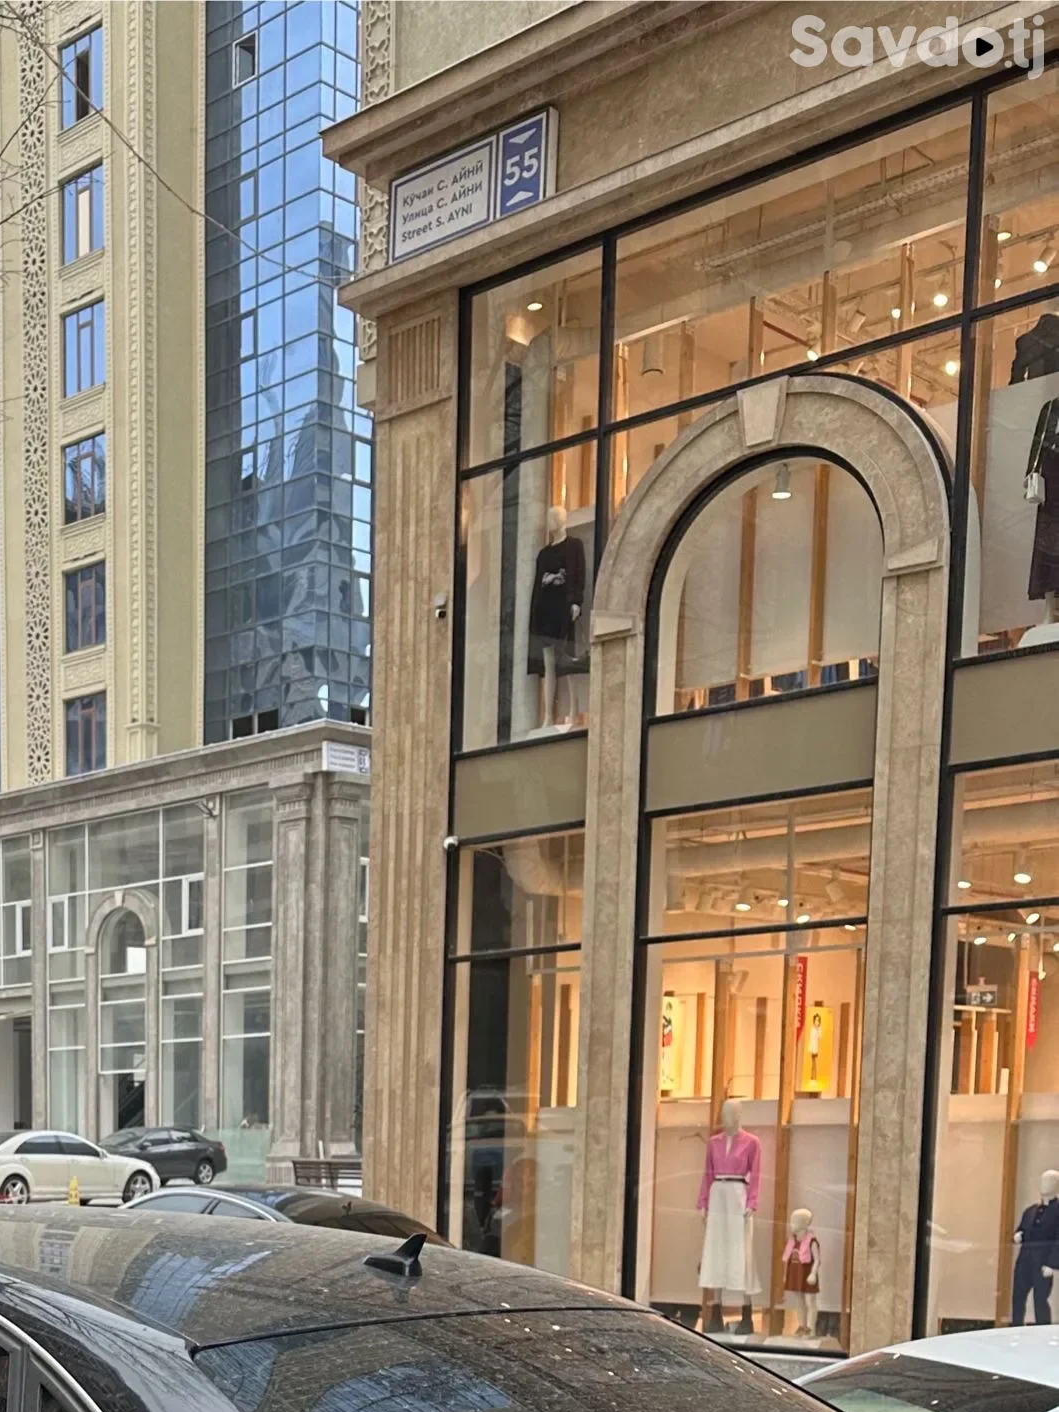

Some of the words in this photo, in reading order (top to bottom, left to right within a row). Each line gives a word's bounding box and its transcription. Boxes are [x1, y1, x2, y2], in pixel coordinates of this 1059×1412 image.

[437, 180, 448, 191] С.
[504, 147, 539, 187] 55
[402, 205, 433, 225] Улица
[436, 197, 448, 209] С.
[450, 182, 482, 204] АЙНИ
[402, 221, 433, 243] Street
[436, 216, 445, 227] S.
[447, 203, 473, 223] AYNI
